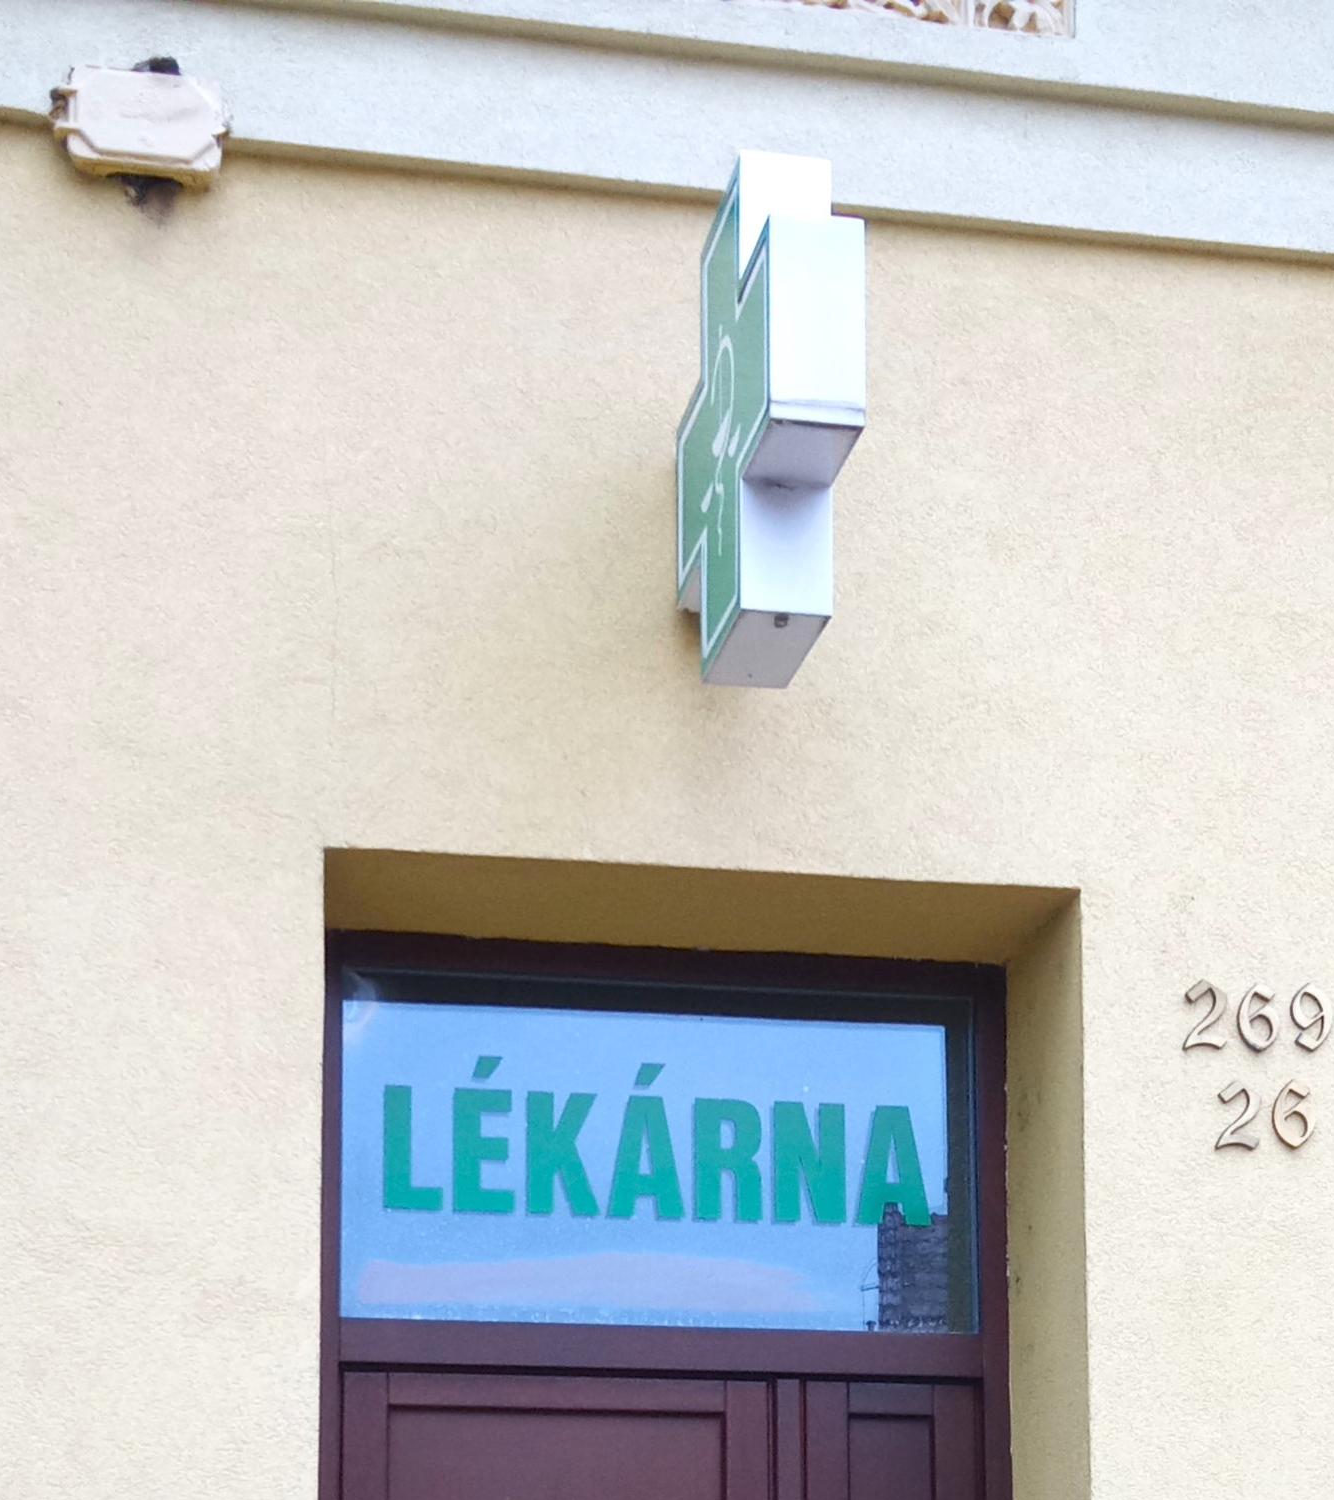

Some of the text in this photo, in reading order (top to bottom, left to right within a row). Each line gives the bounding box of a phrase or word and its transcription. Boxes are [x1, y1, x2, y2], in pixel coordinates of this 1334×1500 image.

[1182, 979, 1332, 1052] 269
[382, 1055, 933, 1226] LÉKÁRNA
[1214, 1079, 1316, 1150] 26
